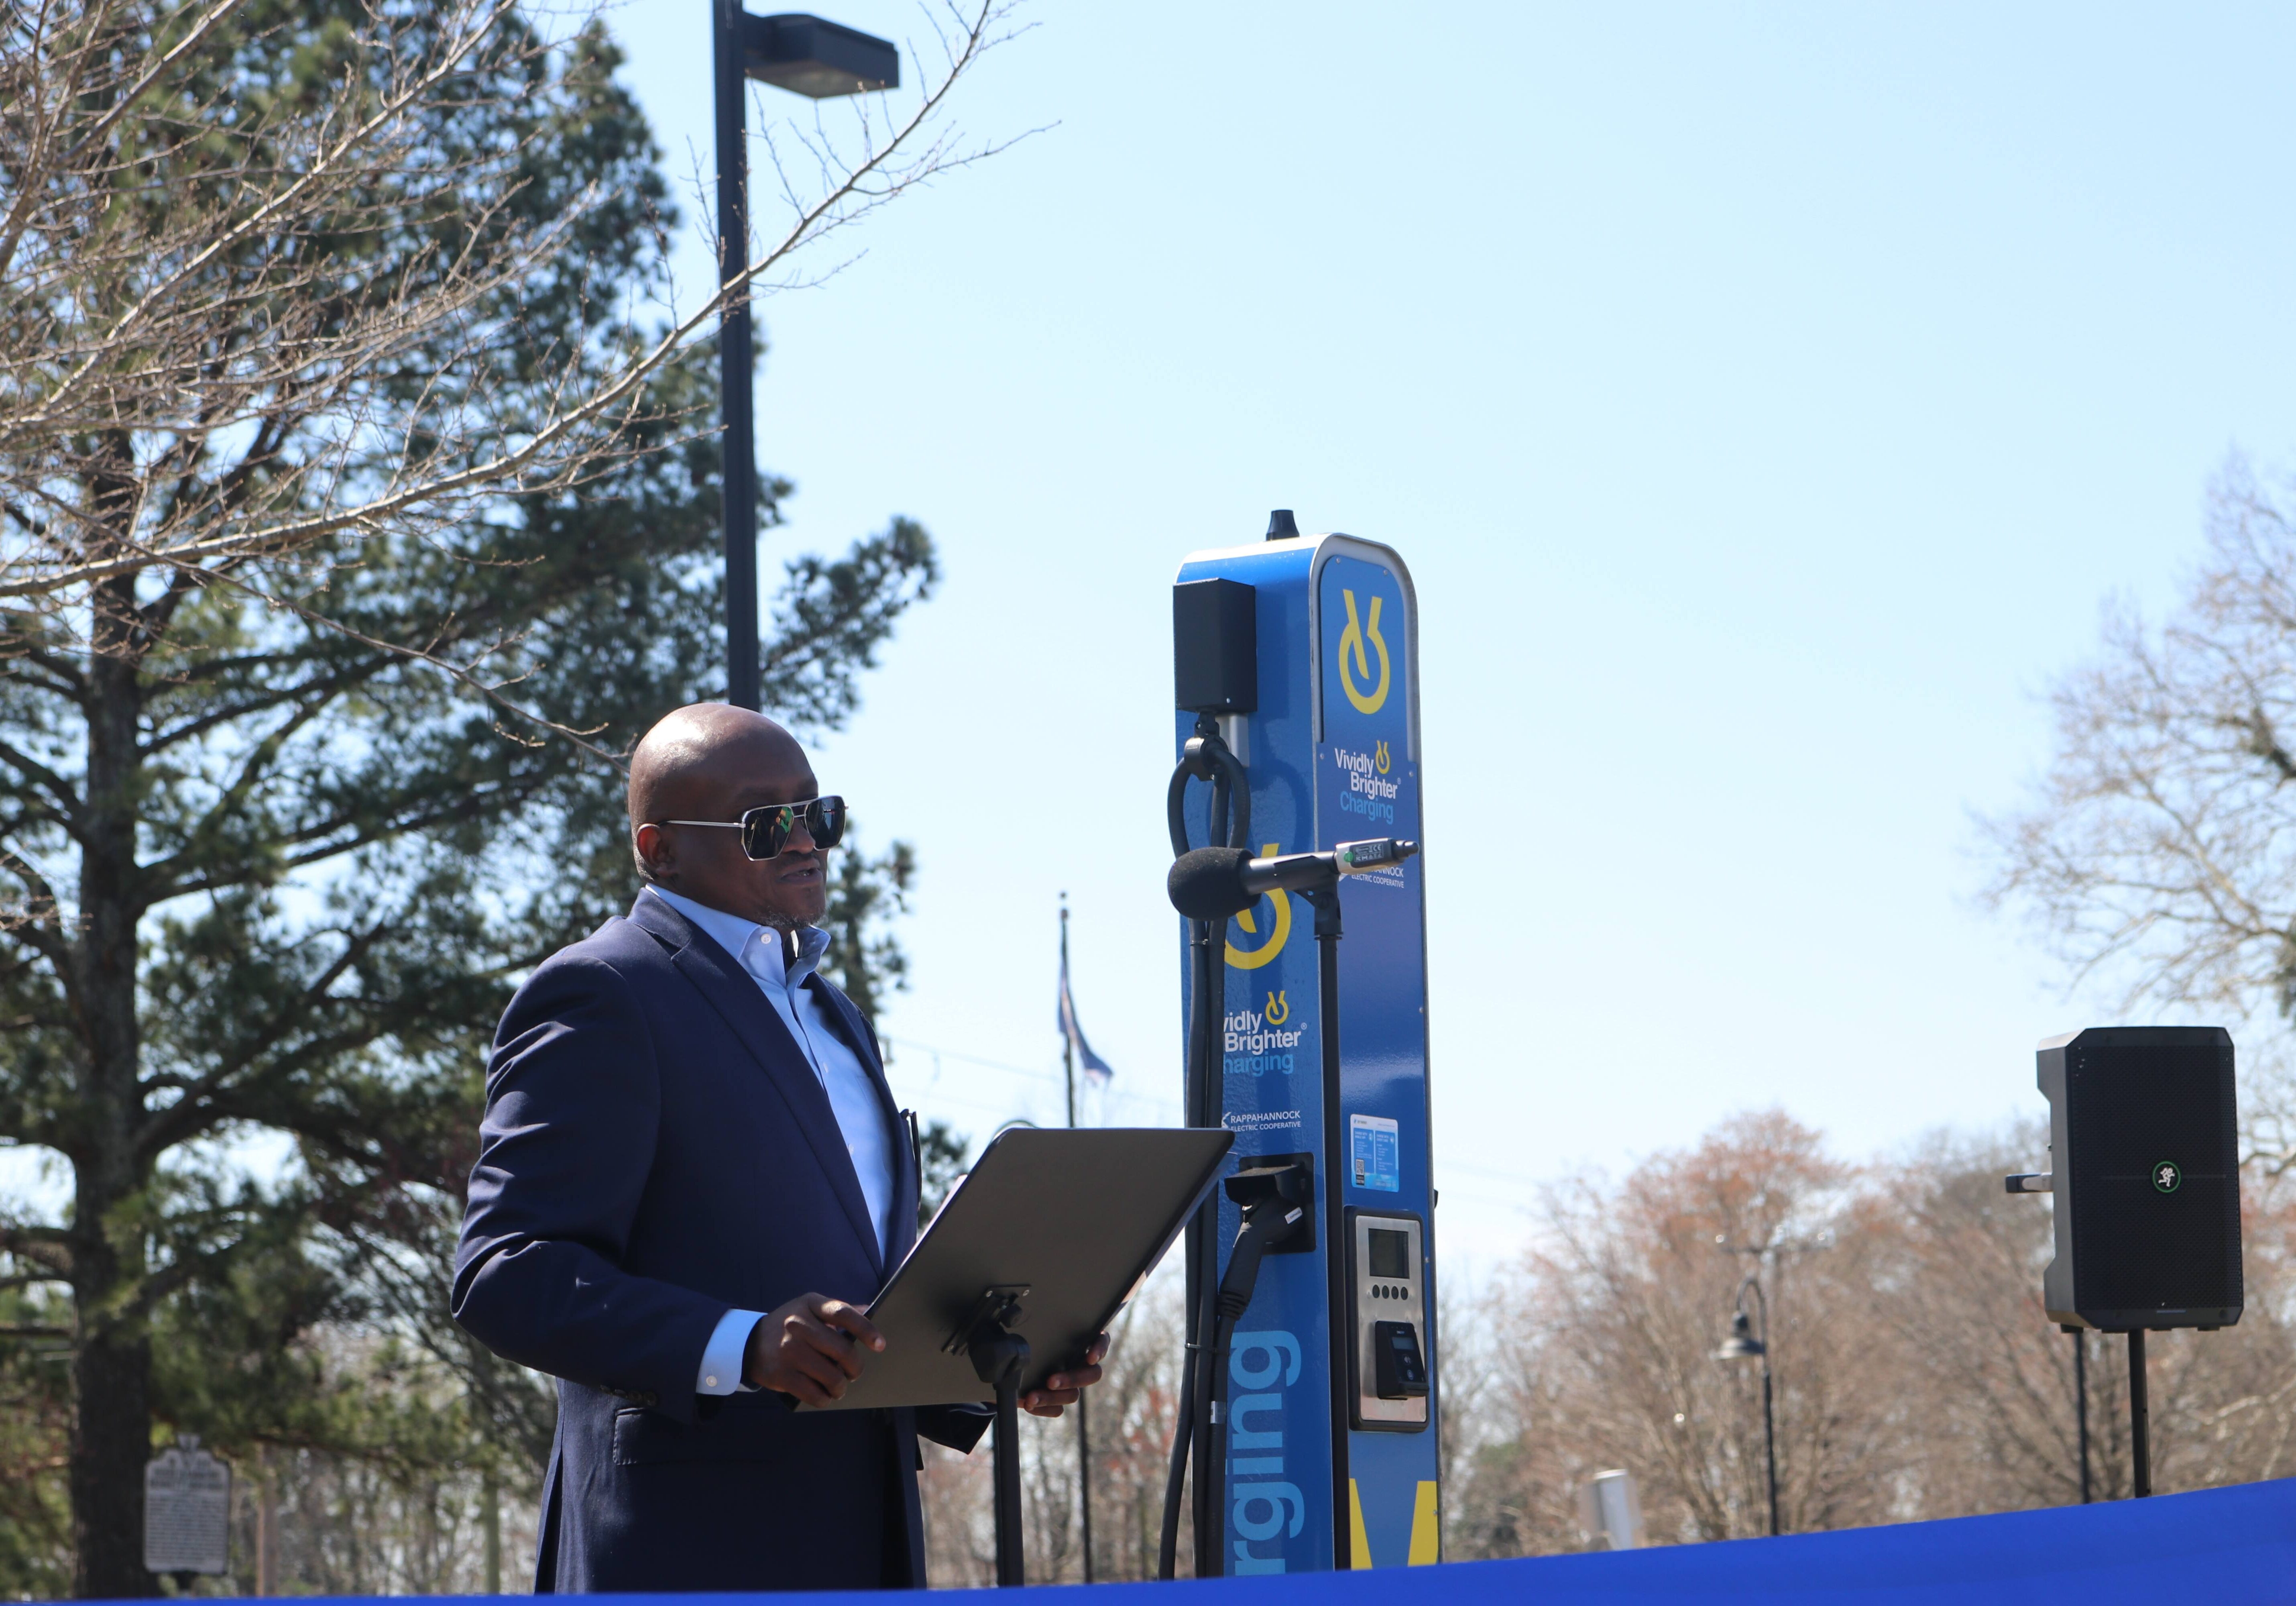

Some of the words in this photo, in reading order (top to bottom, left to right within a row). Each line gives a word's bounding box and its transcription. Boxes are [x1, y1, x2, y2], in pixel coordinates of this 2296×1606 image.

[1335, 748, 1374, 778] Vividly
[1340, 791, 1394, 825] Charging
[1351, 874, 1373, 882] ELECTRIC
[1373, 876, 1404, 889] COOPERATIVE
[1223, 1051, 1294, 1077] harging
[1230, 1110, 1301, 1124] RAPPAHANNOCK
[1231, 1124, 1258, 1132] ELECTRIC
[1259, 1121, 1301, 1130] COOPERATIVE
[1225, 1330, 1305, 1576] rging
